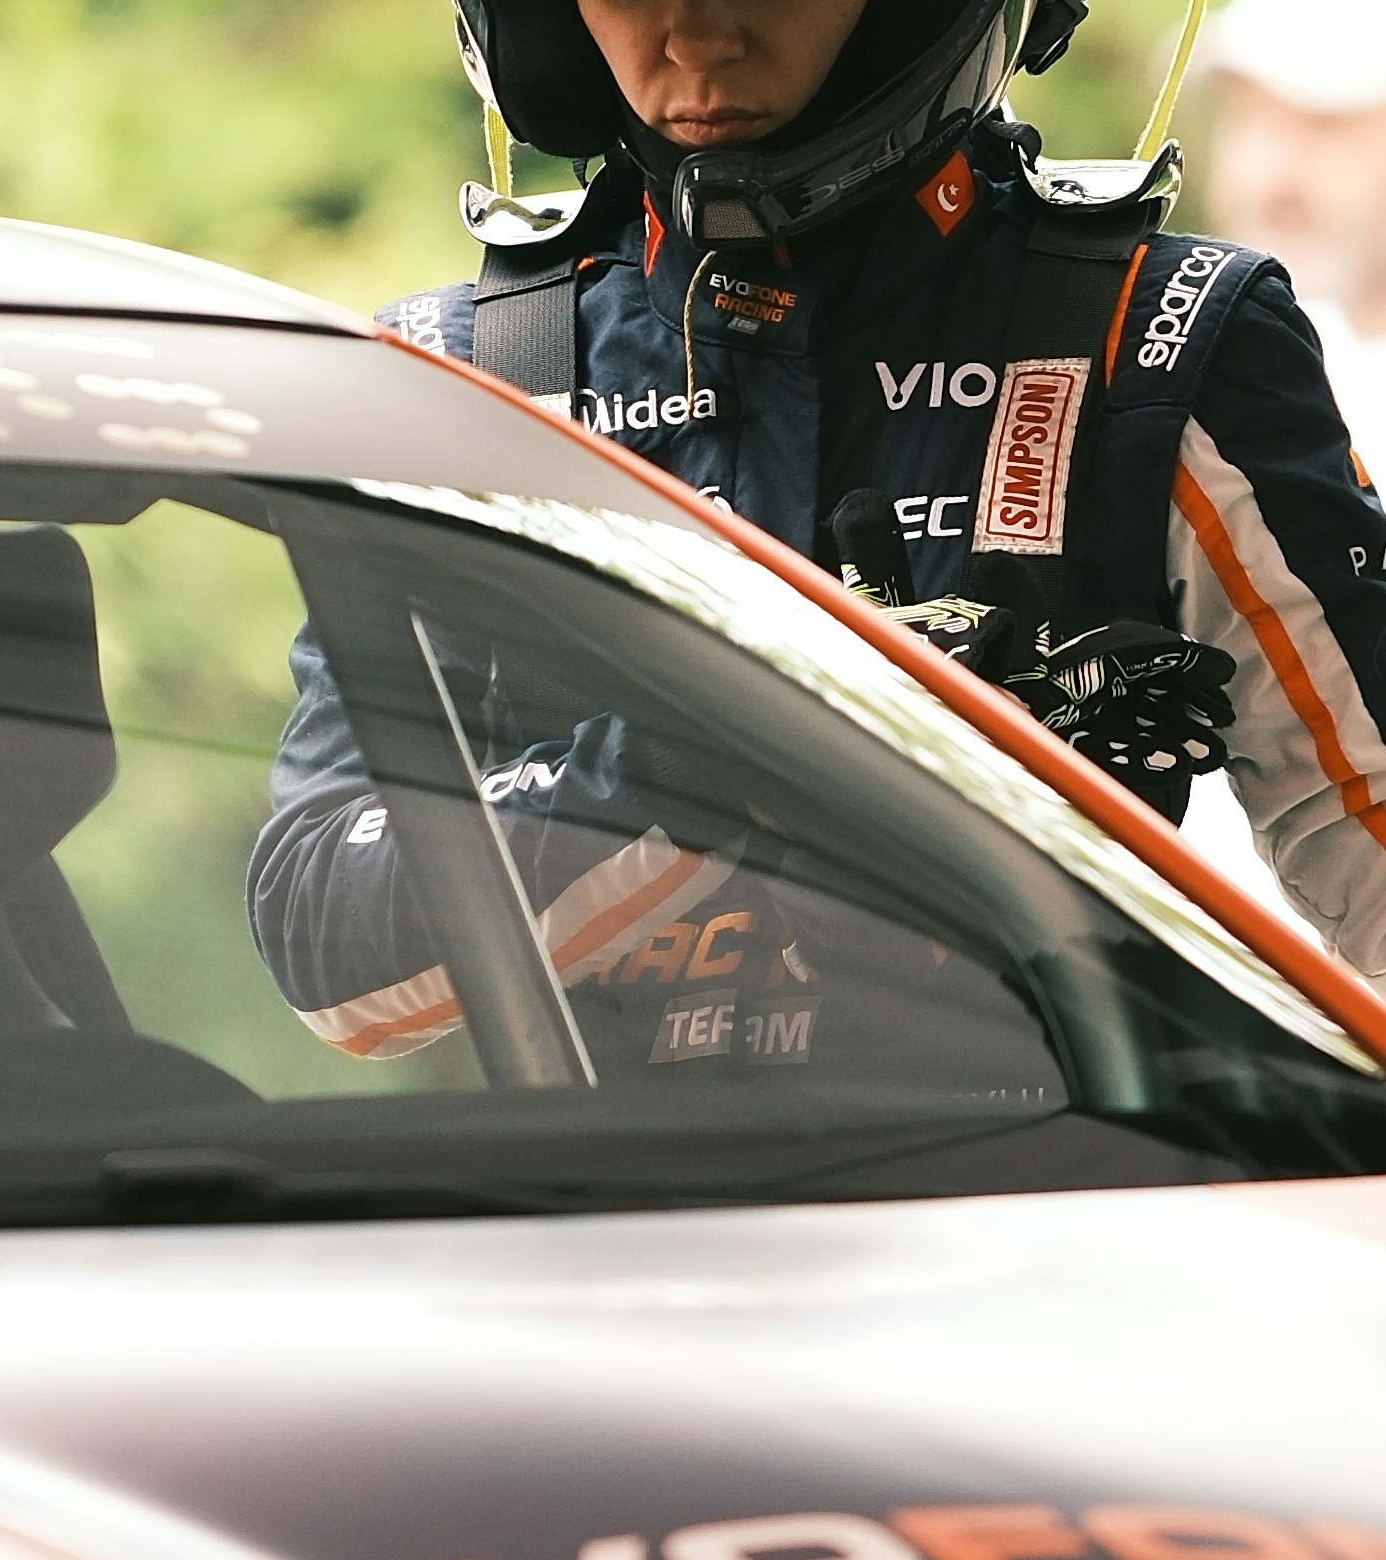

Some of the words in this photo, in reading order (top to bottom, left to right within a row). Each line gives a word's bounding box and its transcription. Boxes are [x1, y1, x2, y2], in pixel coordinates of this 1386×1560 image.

[709, 273, 798, 307] EVOFONE
[714, 292, 786, 323] RACING
[1138, 246, 1226, 368] sparco
[582, 388, 717, 436] Midea
[999, 383, 1059, 530] SIMPSON
